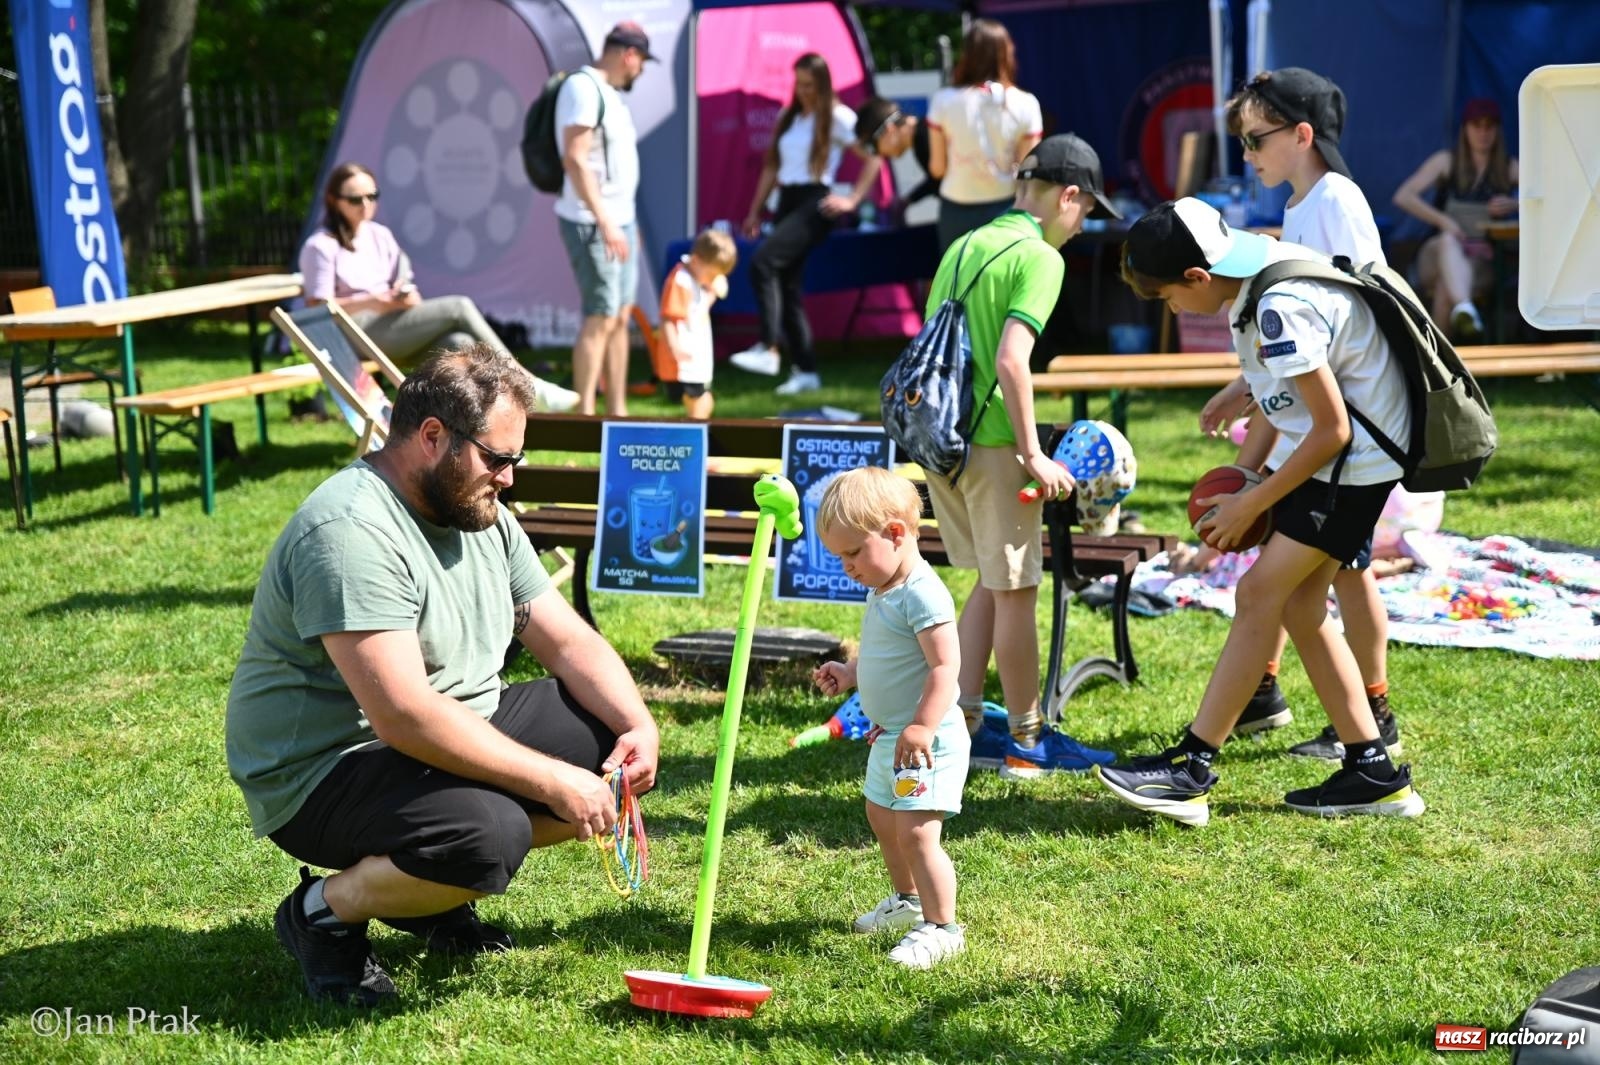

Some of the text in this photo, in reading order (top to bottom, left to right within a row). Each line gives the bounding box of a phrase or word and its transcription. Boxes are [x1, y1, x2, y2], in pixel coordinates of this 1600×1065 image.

[619, 444, 693, 458] OSTROG.NET
[796, 438, 882, 454] OSTROG.NET
[631, 458, 681, 471] POLECA
[807, 453, 868, 468] POLECA
[603, 567, 649, 579] MATCHA
